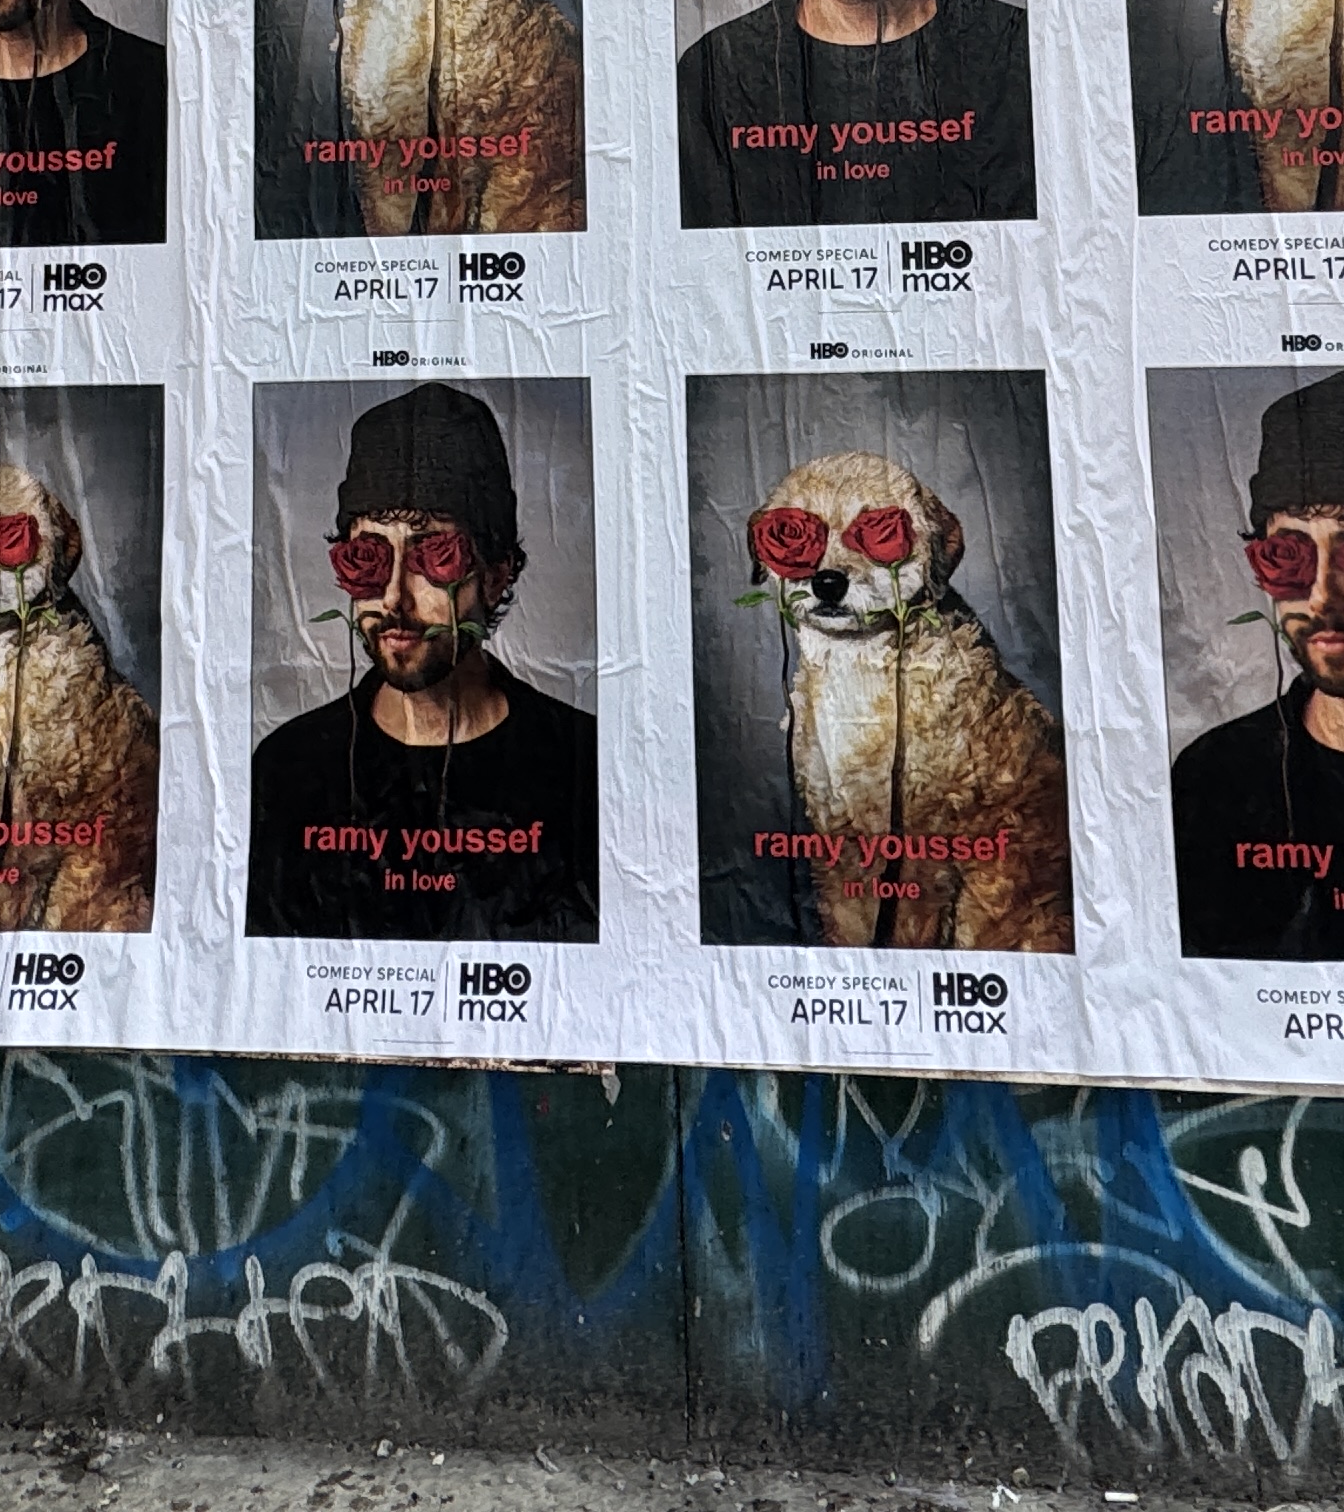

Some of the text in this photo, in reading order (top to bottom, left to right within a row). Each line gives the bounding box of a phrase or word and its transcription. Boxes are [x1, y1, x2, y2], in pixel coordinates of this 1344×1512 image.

[731, 110, 975, 154] ramy youssef
[1189, 109, 1284, 139] ramy
[303, 127, 532, 167] ramy youssef
[1282, 148, 1304, 167] in
[816, 160, 890, 179] in love
[383, 174, 451, 194] in love
[745, 247, 878, 262] COMEDY SPECIAL
[901, 239, 973, 270] HBO
[1208, 238, 1280, 252] COMEDY
[43, 262, 108, 292] HBO
[314, 259, 440, 274] COMEDY SPECIAL
[458, 251, 526, 282] HBO
[1232, 258, 1316, 281] APRIL
[334, 277, 439, 300] APRIL 17
[767, 267, 878, 291] APRIL 17
[901, 270, 973, 293] max
[43, 292, 105, 312] max
[459, 281, 525, 303] max
[809, 342, 914, 360] HBO ORIGINAL
[1280, 334, 1322, 352] HBO
[372, 350, 467, 367] HBO ORIGINAL
[303, 820, 544, 861] ramy youssef
[753, 828, 1010, 867] ramy youssef
[1235, 841, 1334, 878] ramy
[384, 868, 456, 892] in love
[842, 877, 921, 899] in love
[11, 952, 85, 986] HBO
[306, 965, 436, 982] COMEDY SPECIAL
[459, 962, 532, 997] HBO
[767, 974, 908, 991] COMEDY SPECIAL
[932, 971, 1009, 1008] HBO
[8, 988, 80, 1011] max
[324, 988, 435, 1016] APRIL 17
[1256, 988, 1332, 1004] COMEDY
[457, 998, 528, 1023] max
[791, 998, 908, 1026] APRIL 17
[934, 1008, 1008, 1034] max
